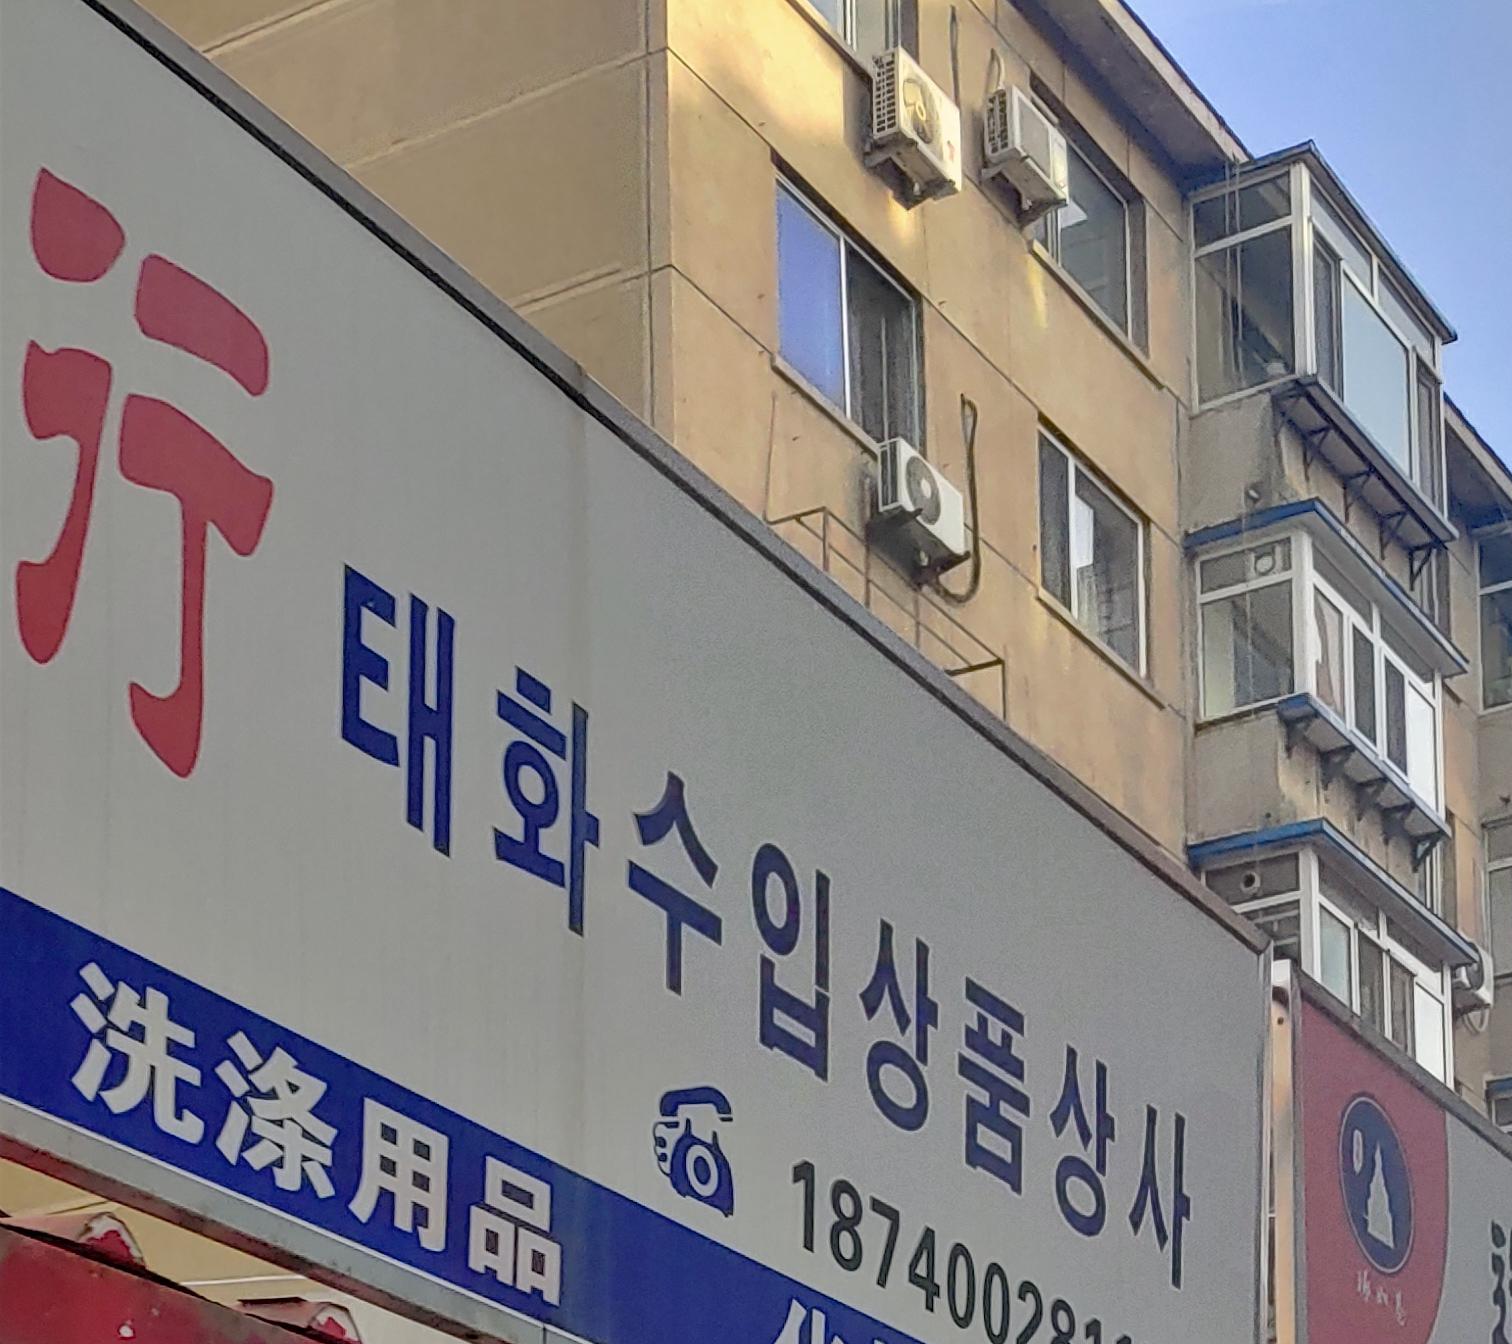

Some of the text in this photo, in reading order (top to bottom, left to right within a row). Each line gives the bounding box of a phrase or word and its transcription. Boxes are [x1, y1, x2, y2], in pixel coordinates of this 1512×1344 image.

[15, 165, 274, 779] 行
[70, 961, 562, 1307] 洗涤用品
[341, 562, 1192, 1289] 태화수입상품상사
